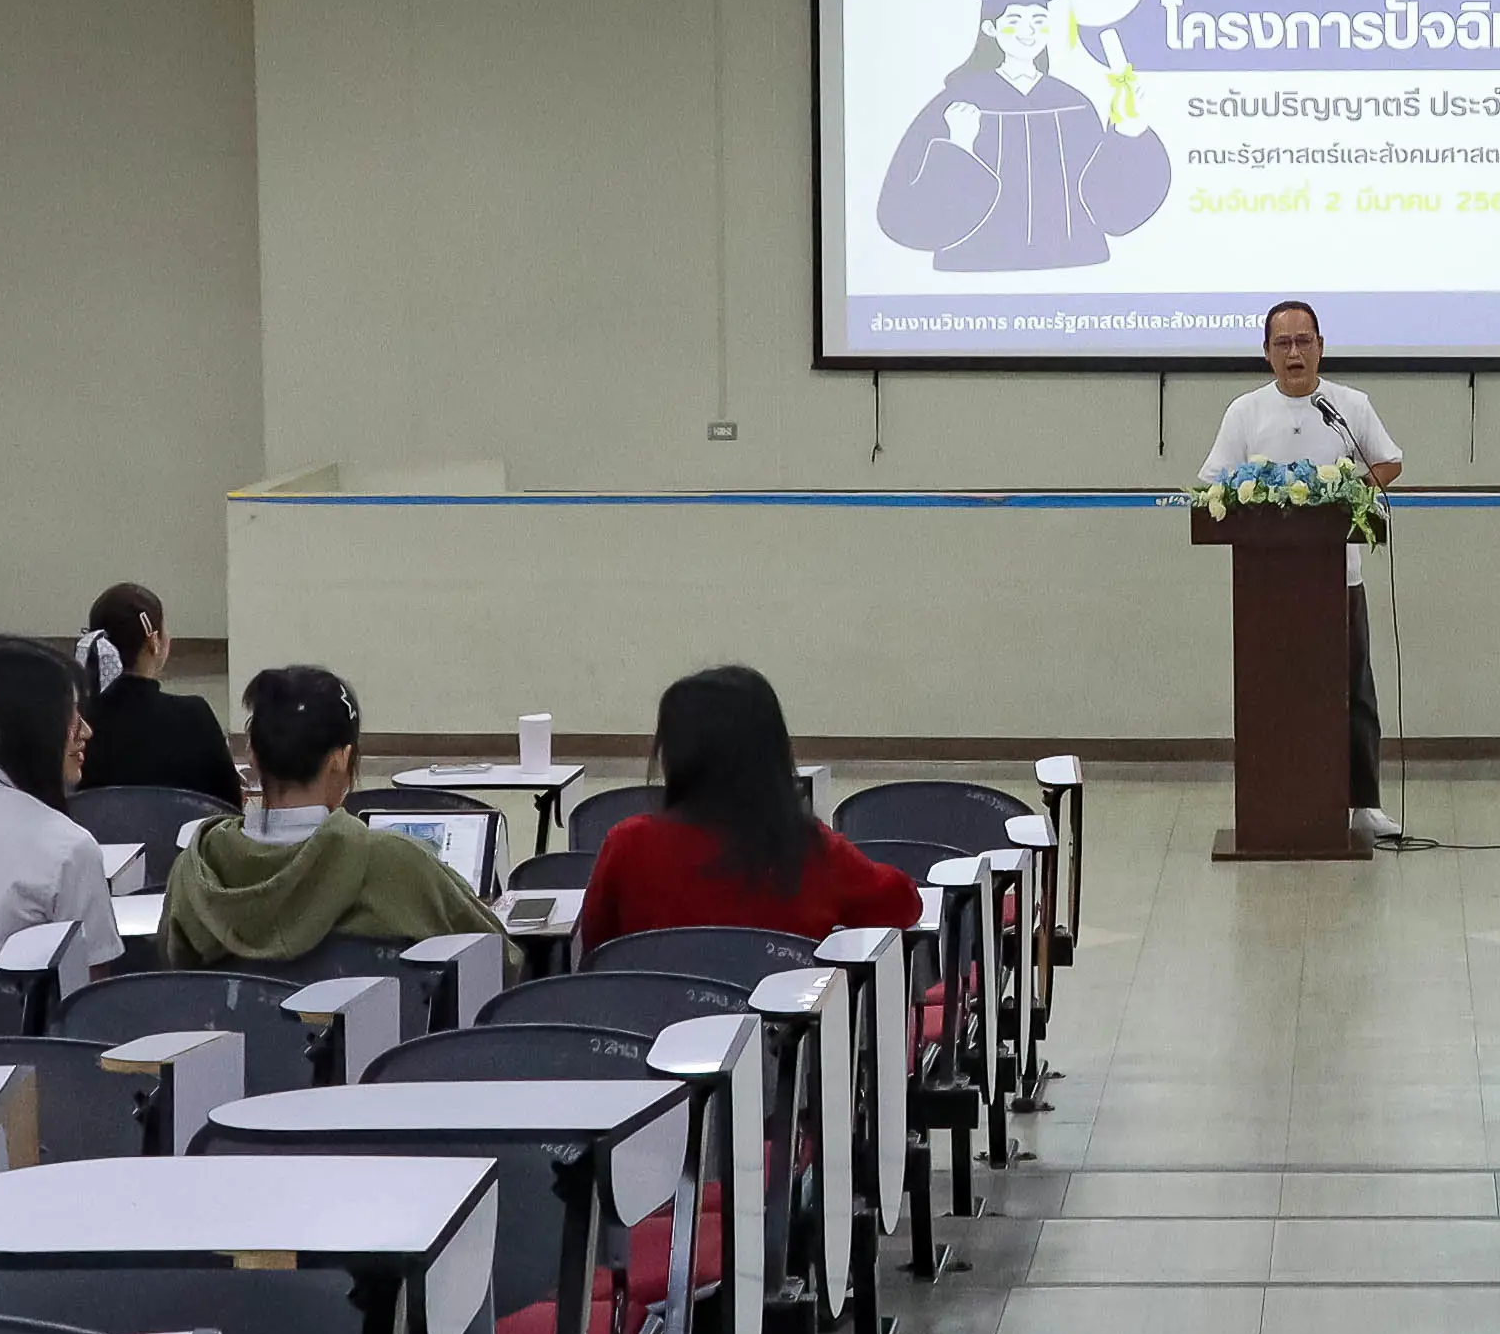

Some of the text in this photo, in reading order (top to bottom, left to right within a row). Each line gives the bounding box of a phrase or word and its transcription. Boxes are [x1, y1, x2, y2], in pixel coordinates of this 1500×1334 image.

[1188, 88, 1421, 121] ระดับปริญญาตรี
[1325, 192, 1340, 213] 2
[1356, 186, 1441, 214] มีนาคม
[871, 313, 1008, 332] ส่วนงานวิชาการ
